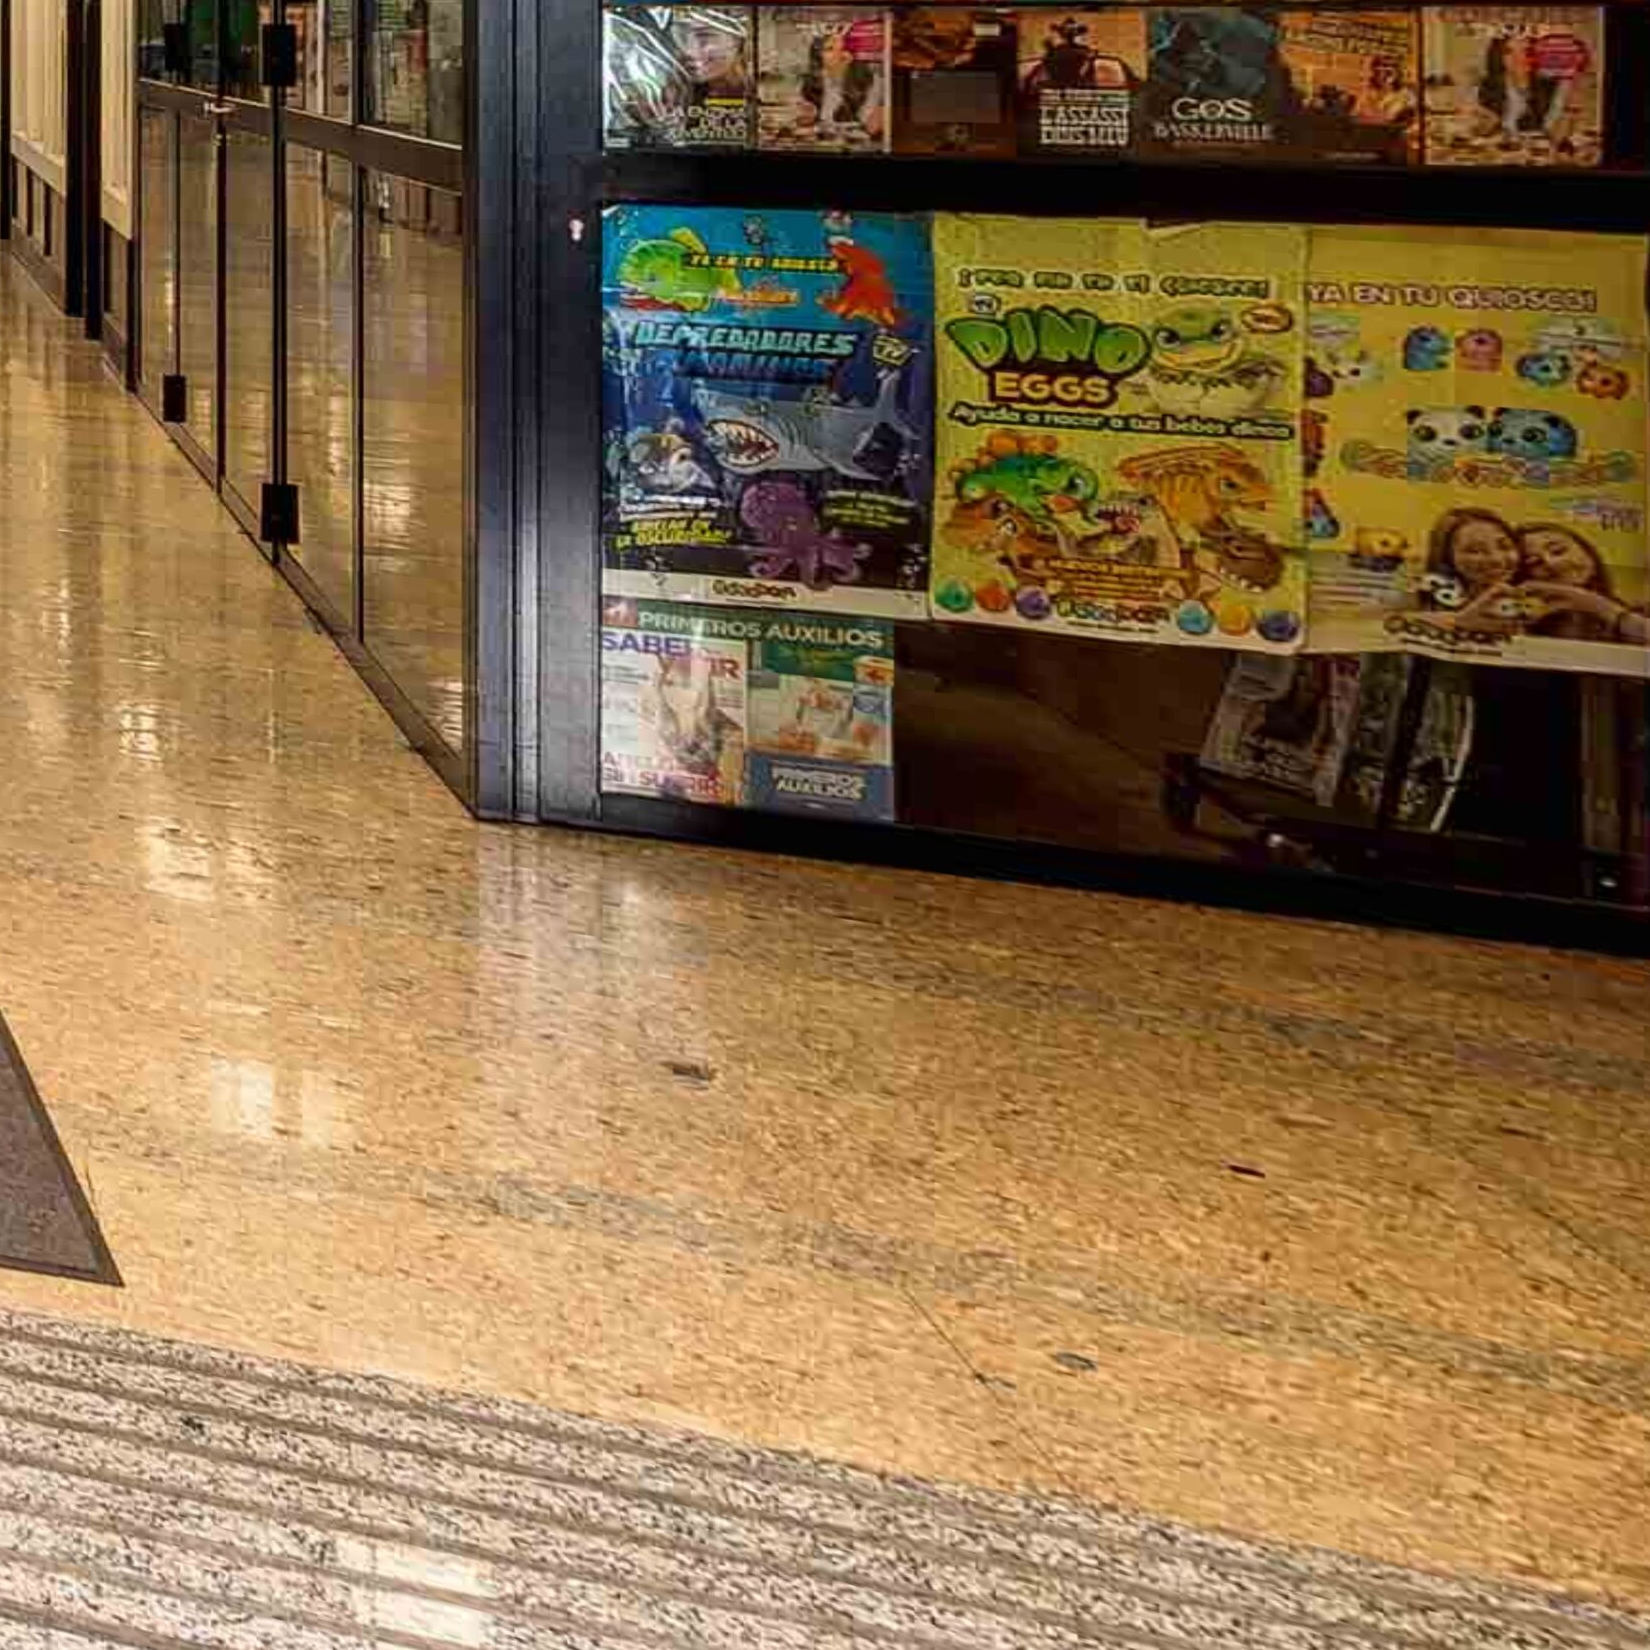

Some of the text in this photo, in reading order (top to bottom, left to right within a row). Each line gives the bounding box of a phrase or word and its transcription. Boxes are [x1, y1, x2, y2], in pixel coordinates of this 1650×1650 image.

[1307, 283, 1346, 306] YA
[1352, 285, 1399, 307] EN
[1402, 287, 1440, 308] TU
[944, 305, 1151, 378] DINO
[994, 371, 1112, 404] EGGS
[763, 620, 884, 650] AUXILIOS
